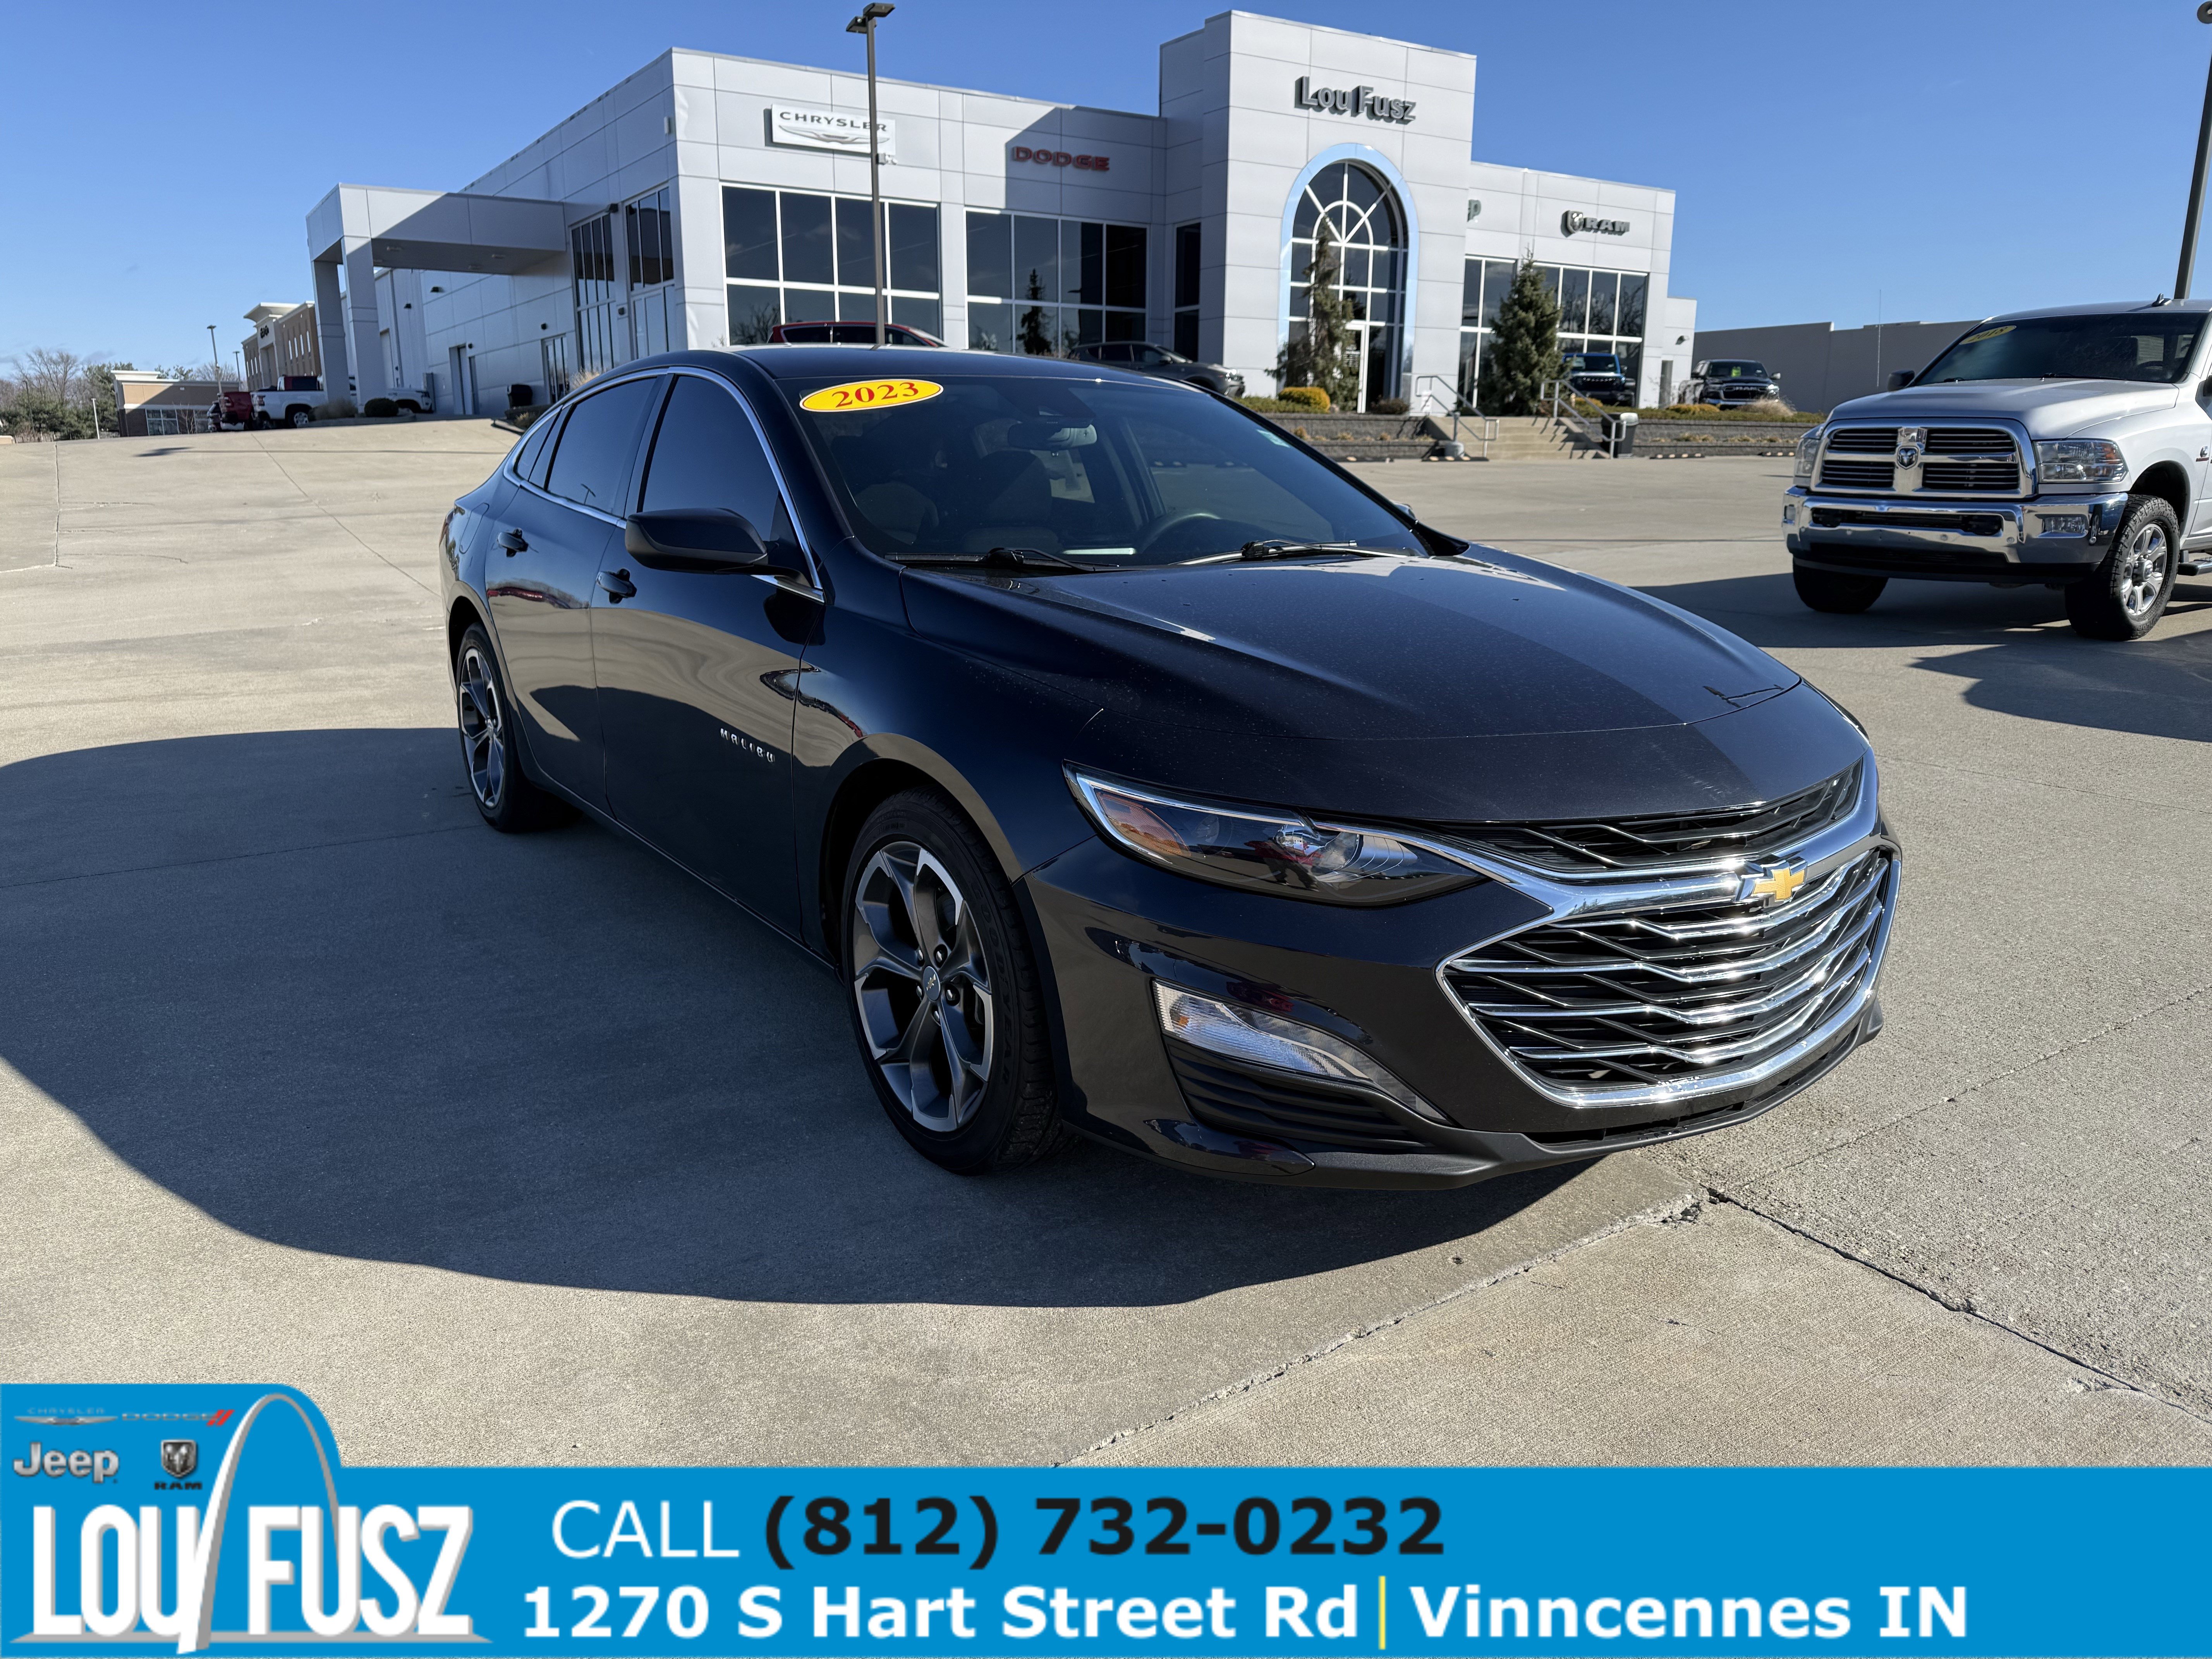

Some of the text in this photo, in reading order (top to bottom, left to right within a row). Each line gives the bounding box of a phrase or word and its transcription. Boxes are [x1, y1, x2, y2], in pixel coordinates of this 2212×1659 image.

[1295, 76, 1417, 122] Lou Fusz
[780, 111, 886, 132] CHRYSLER
[1012, 146, 1109, 171] DODGE
[1584, 217, 1630, 233] RAM
[831, 382, 919, 408] 2023
[720, 728, 774, 762] MALIBU
[970, 882, 1012, 1085] GOODYEAR
